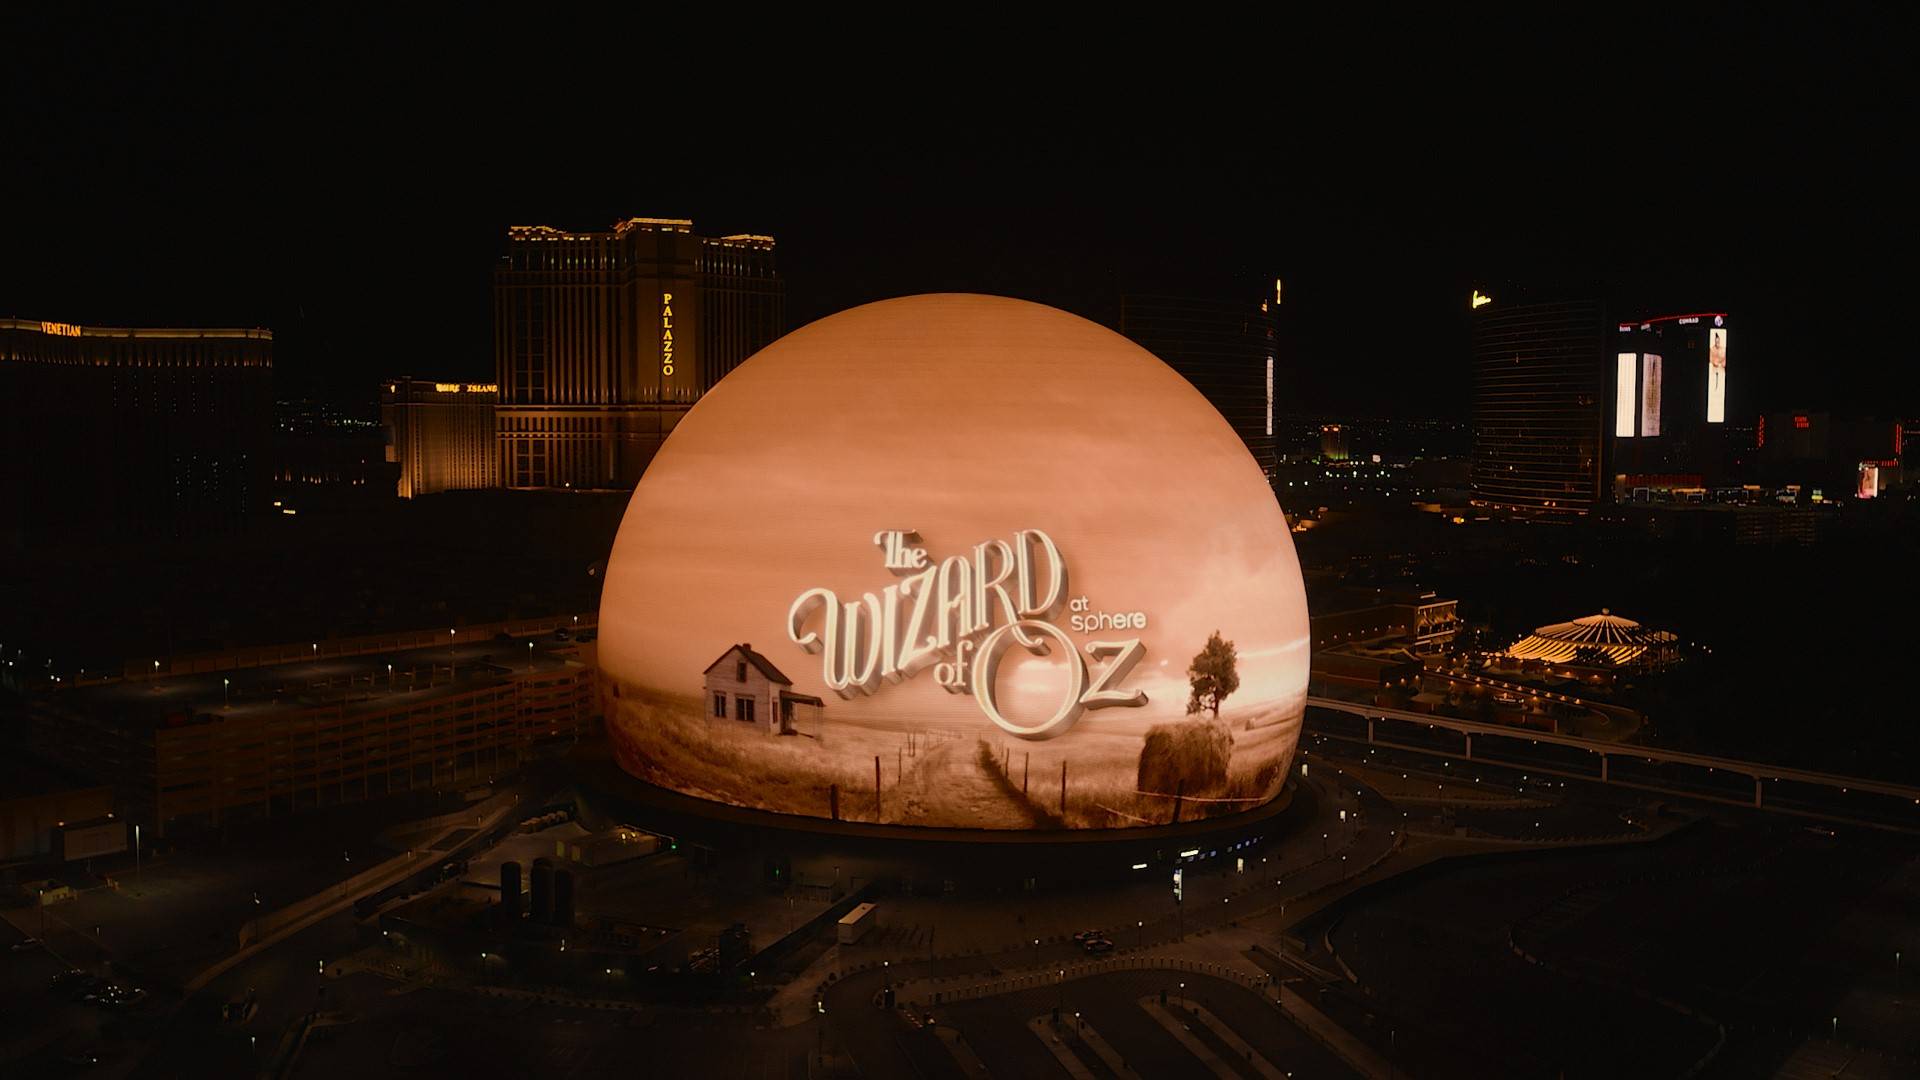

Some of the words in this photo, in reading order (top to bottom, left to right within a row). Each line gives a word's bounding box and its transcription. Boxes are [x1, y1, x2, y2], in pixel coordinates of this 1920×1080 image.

[41, 321, 81, 337] VENETIAN
[662, 293, 674, 376] PALAZZO
[466, 384, 498, 392] ISLAND
[873, 530, 927, 570] The
[787, 528, 1064, 693] WIZARD
[1070, 596, 1088, 611] at
[1071, 611, 1147, 634] sphere
[933, 639, 973, 688] of
